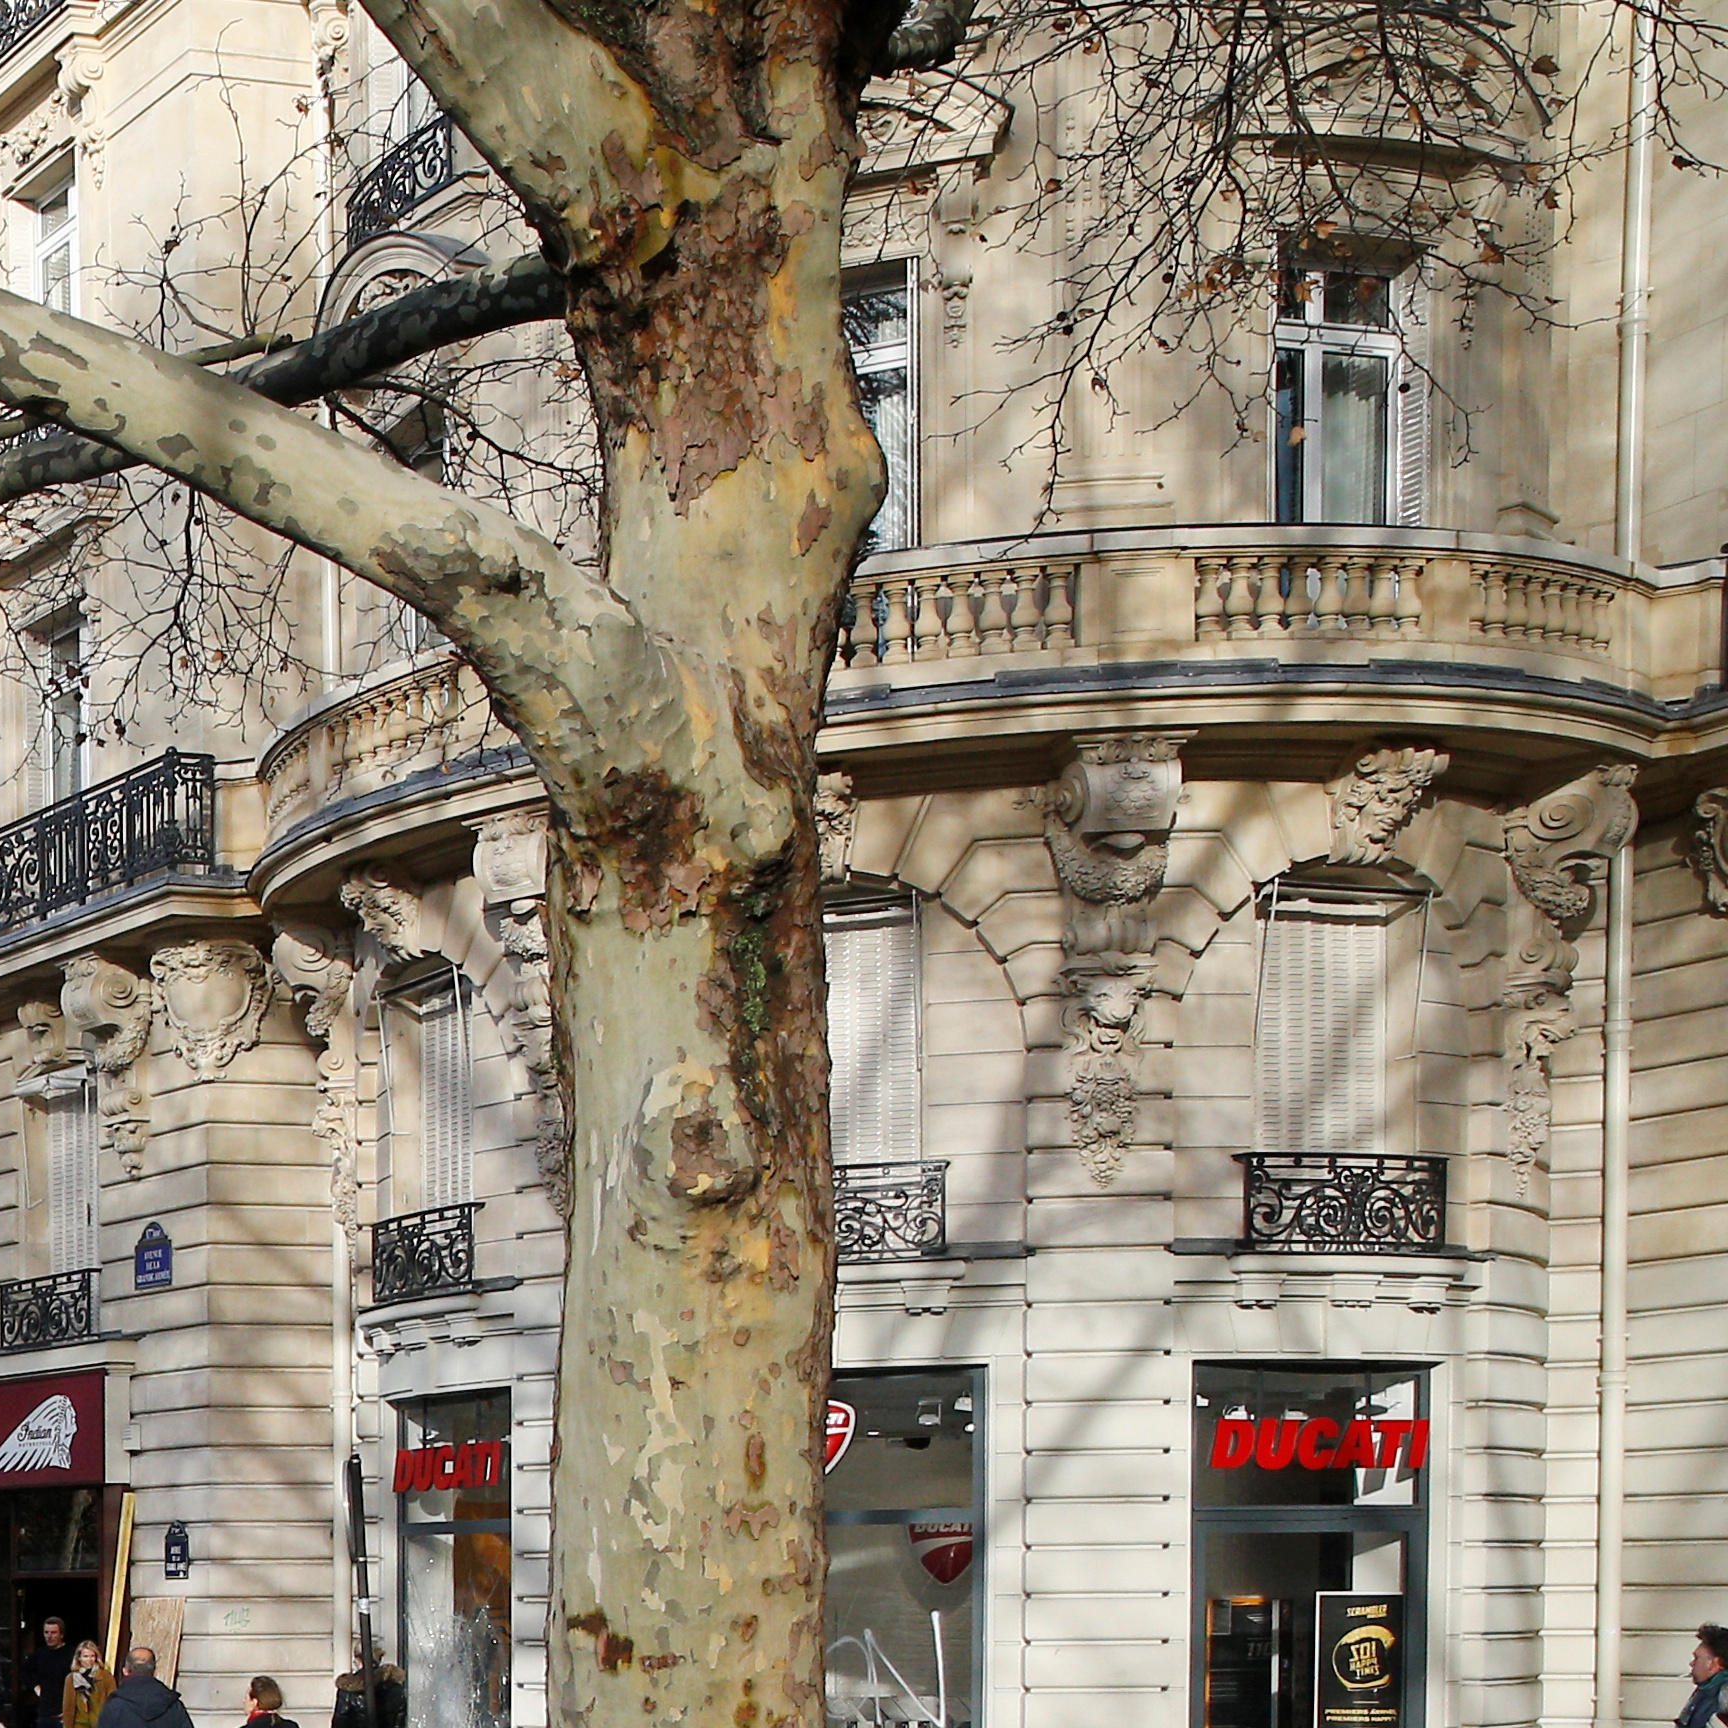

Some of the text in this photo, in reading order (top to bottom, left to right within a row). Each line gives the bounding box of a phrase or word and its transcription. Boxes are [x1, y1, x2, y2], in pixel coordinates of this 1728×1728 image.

[16, 1421, 53, 1442] Indian
[1208, 1416, 1431, 1471] DUCATI
[392, 1440, 503, 1493] DUCATI
[913, 1522, 972, 1534] DUCAT
